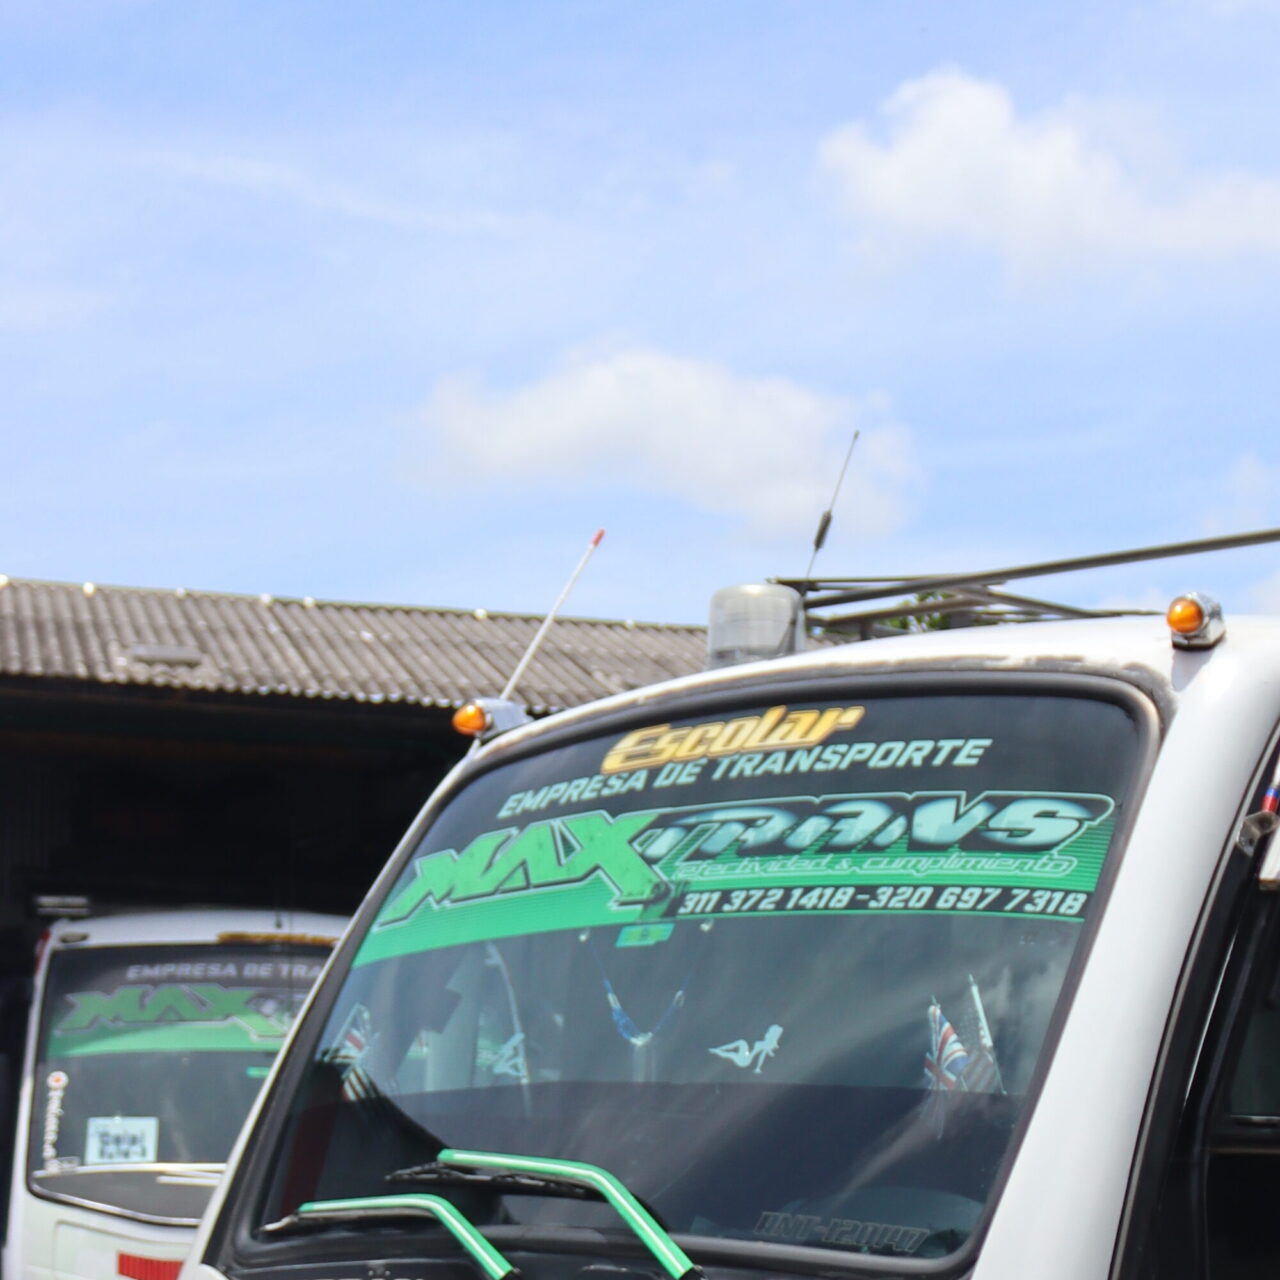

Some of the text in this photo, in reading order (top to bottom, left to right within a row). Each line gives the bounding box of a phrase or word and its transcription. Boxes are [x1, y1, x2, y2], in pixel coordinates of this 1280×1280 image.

[602, 704, 865, 774] Escolar
[496, 739, 993, 819] EMPRESA DE TRANSPORTE
[862, 851, 1073, 877] cumplimiento
[678, 890, 722, 915] 311
[722, 888, 784, 912] 372
[935, 886, 1002, 910] 697
[1003, 888, 1088, 915] 7318
[126, 961, 238, 980] EMPRESA
[241, 962, 276, 979] DE
